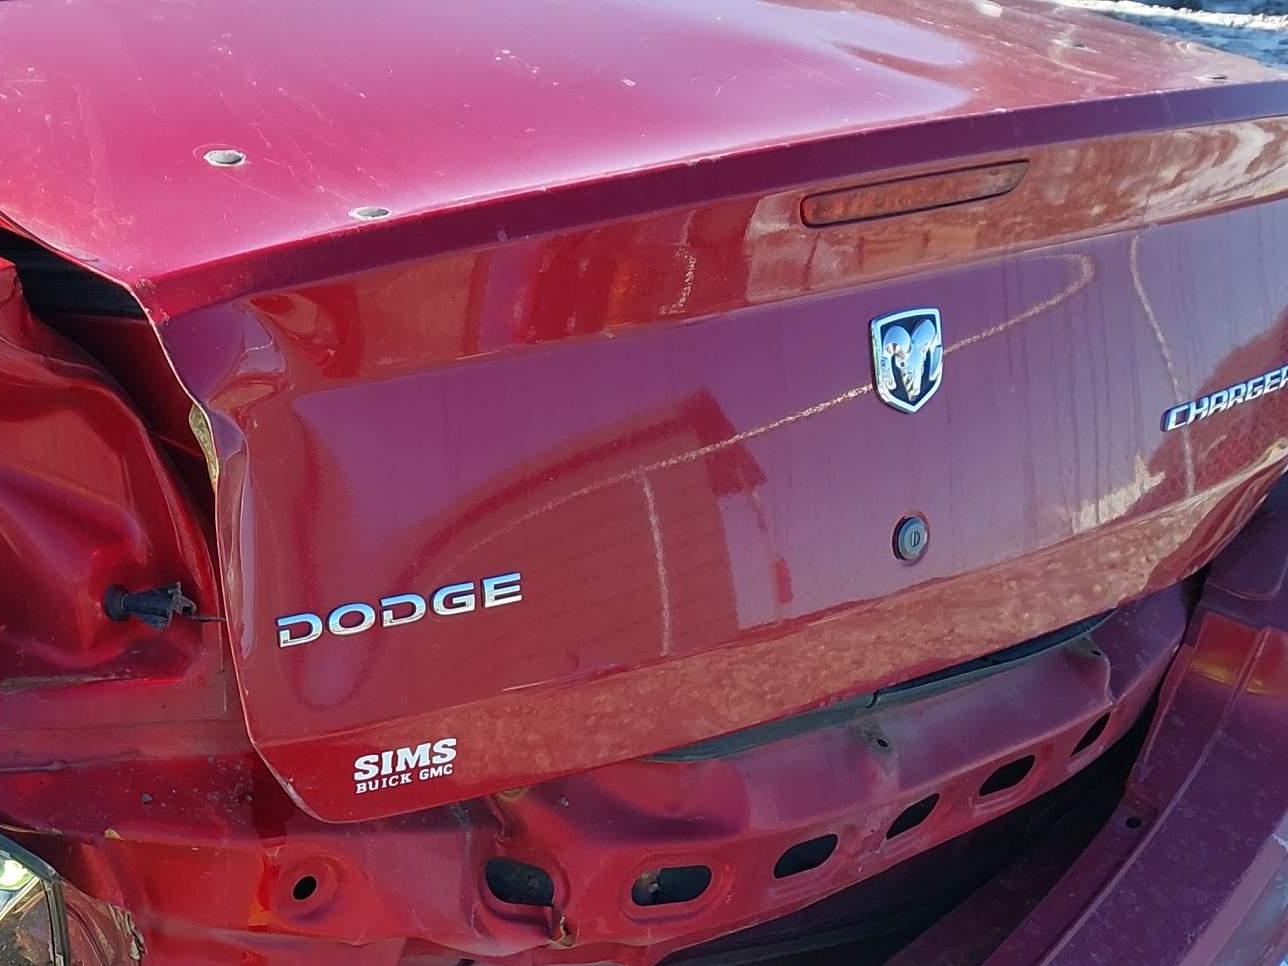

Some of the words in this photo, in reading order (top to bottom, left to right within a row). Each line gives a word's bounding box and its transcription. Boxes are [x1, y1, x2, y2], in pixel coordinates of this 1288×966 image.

[277, 572, 523, 648] DODGE
[353, 738, 457, 781] SIMS
[355, 772, 413, 794] BUICK
[418, 762, 455, 781] GMC
